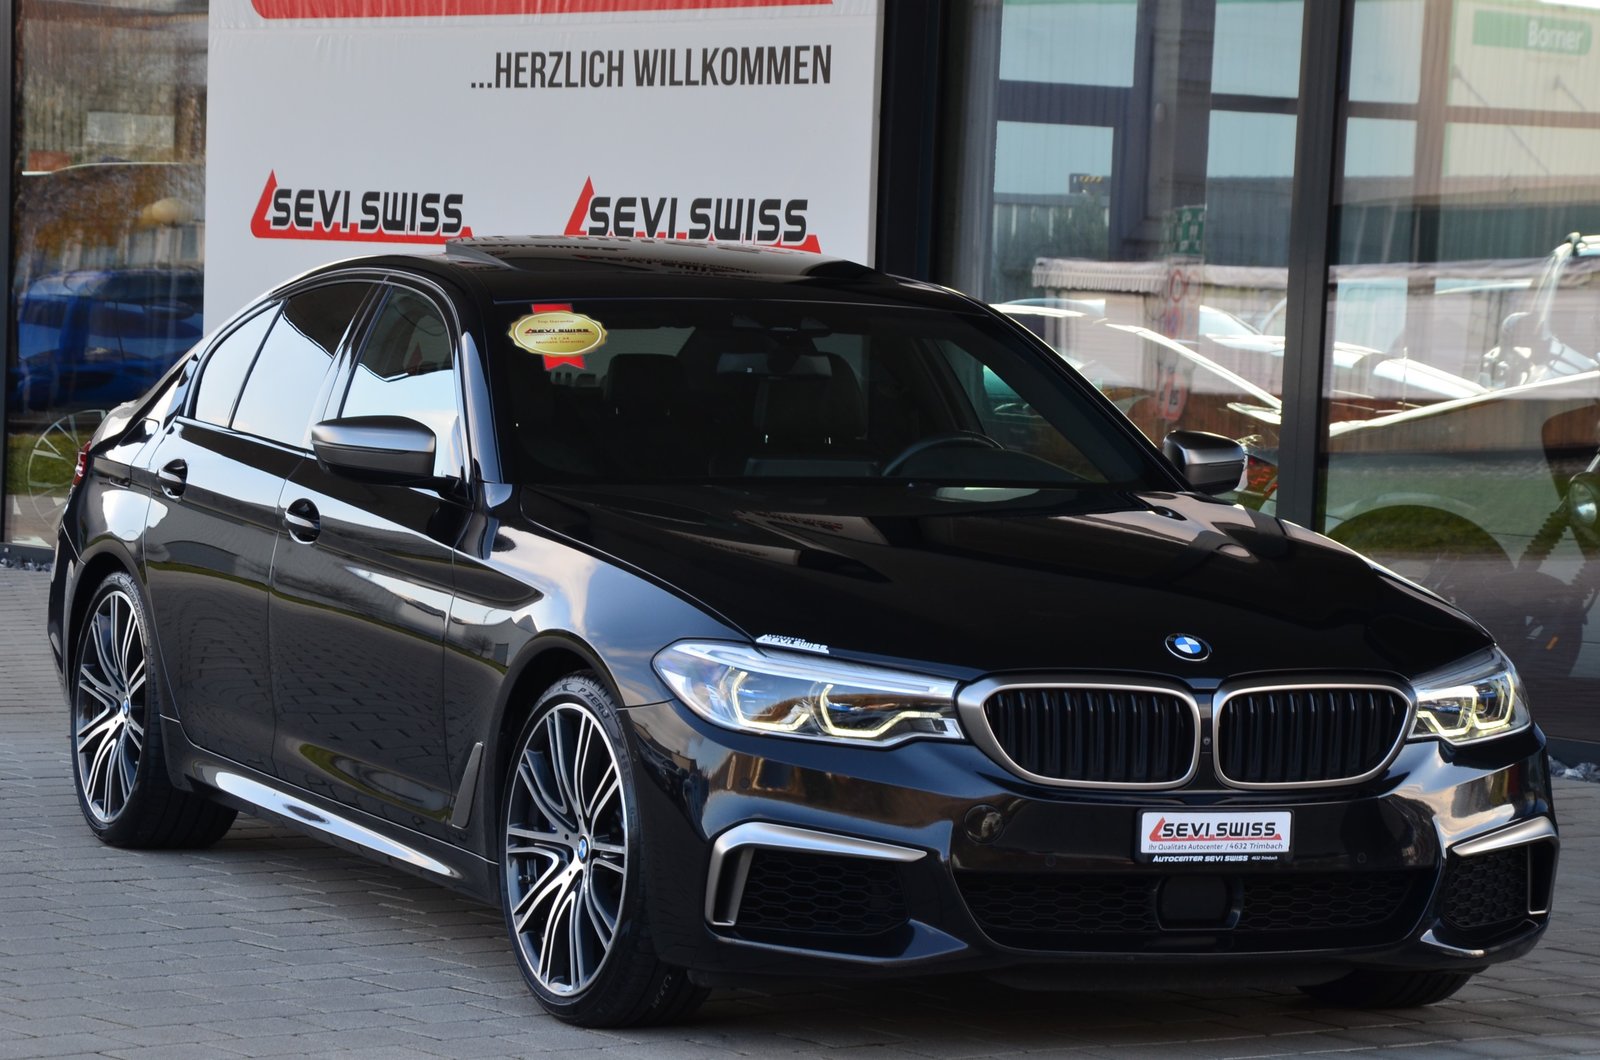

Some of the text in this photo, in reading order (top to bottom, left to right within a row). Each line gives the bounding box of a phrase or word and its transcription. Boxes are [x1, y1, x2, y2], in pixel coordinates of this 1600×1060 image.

[470, 44, 832, 89] ...HERZLICH WILLKOMMEN
[272, 188, 464, 233] SEVI SWISS
[588, 196, 808, 242] SEVI SWISS
[1162, 822, 1276, 837] SEVI SWISS
